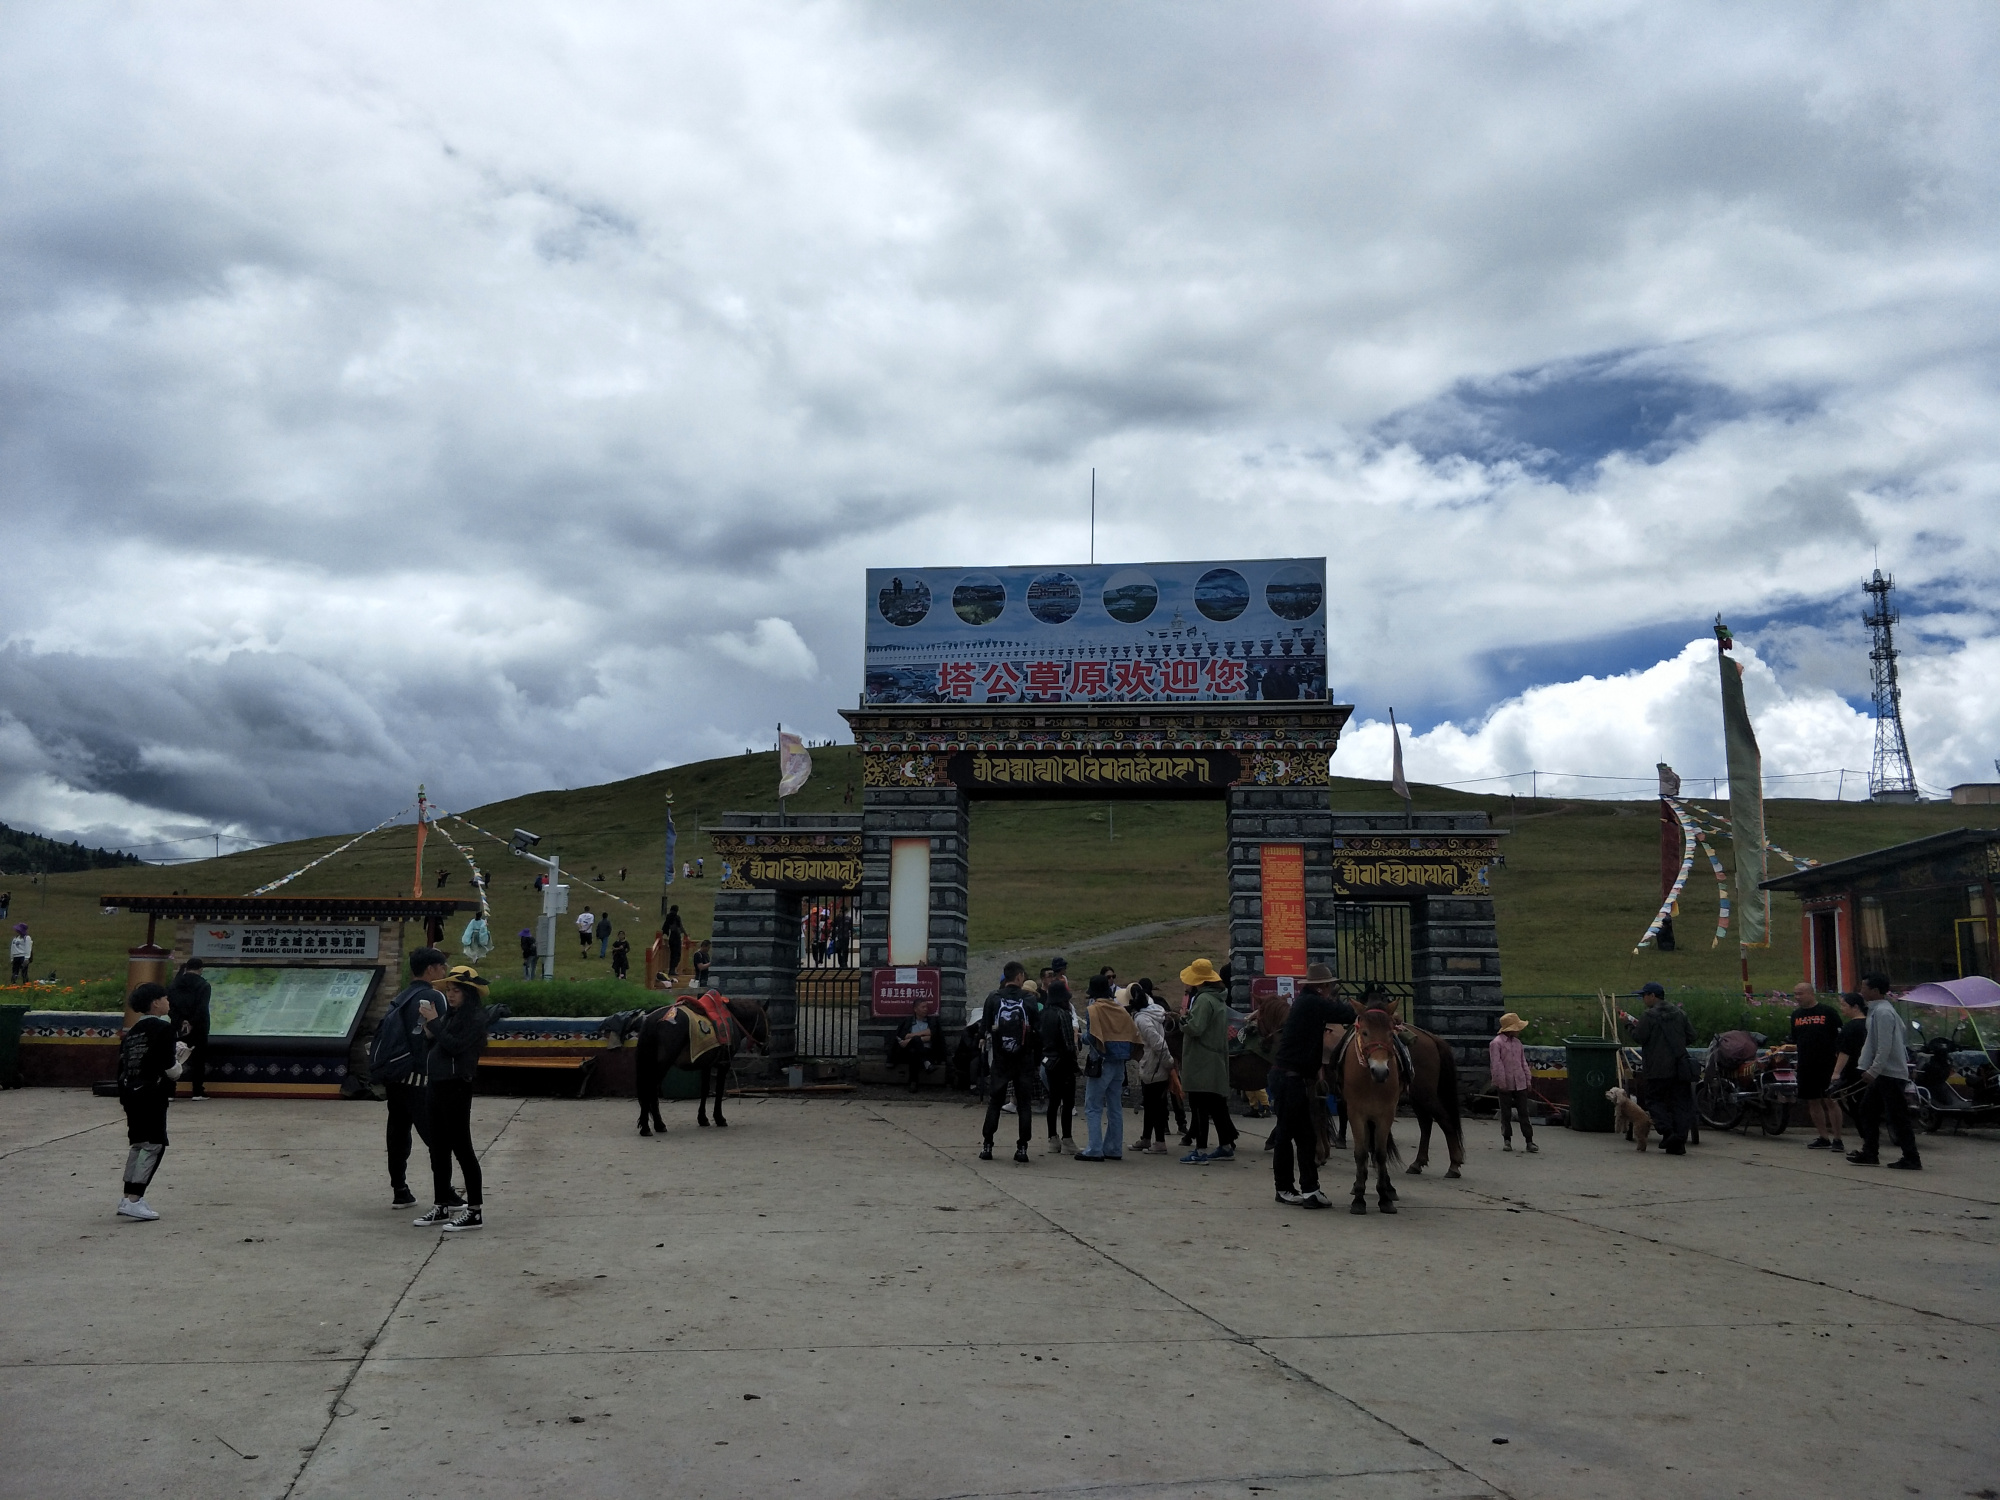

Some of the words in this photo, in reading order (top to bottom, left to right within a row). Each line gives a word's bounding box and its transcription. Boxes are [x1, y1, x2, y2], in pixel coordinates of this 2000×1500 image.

[938, 659, 1247, 697] 塔公草原欢迎您
[1795, 1015, 1826, 1026] MAYBE
